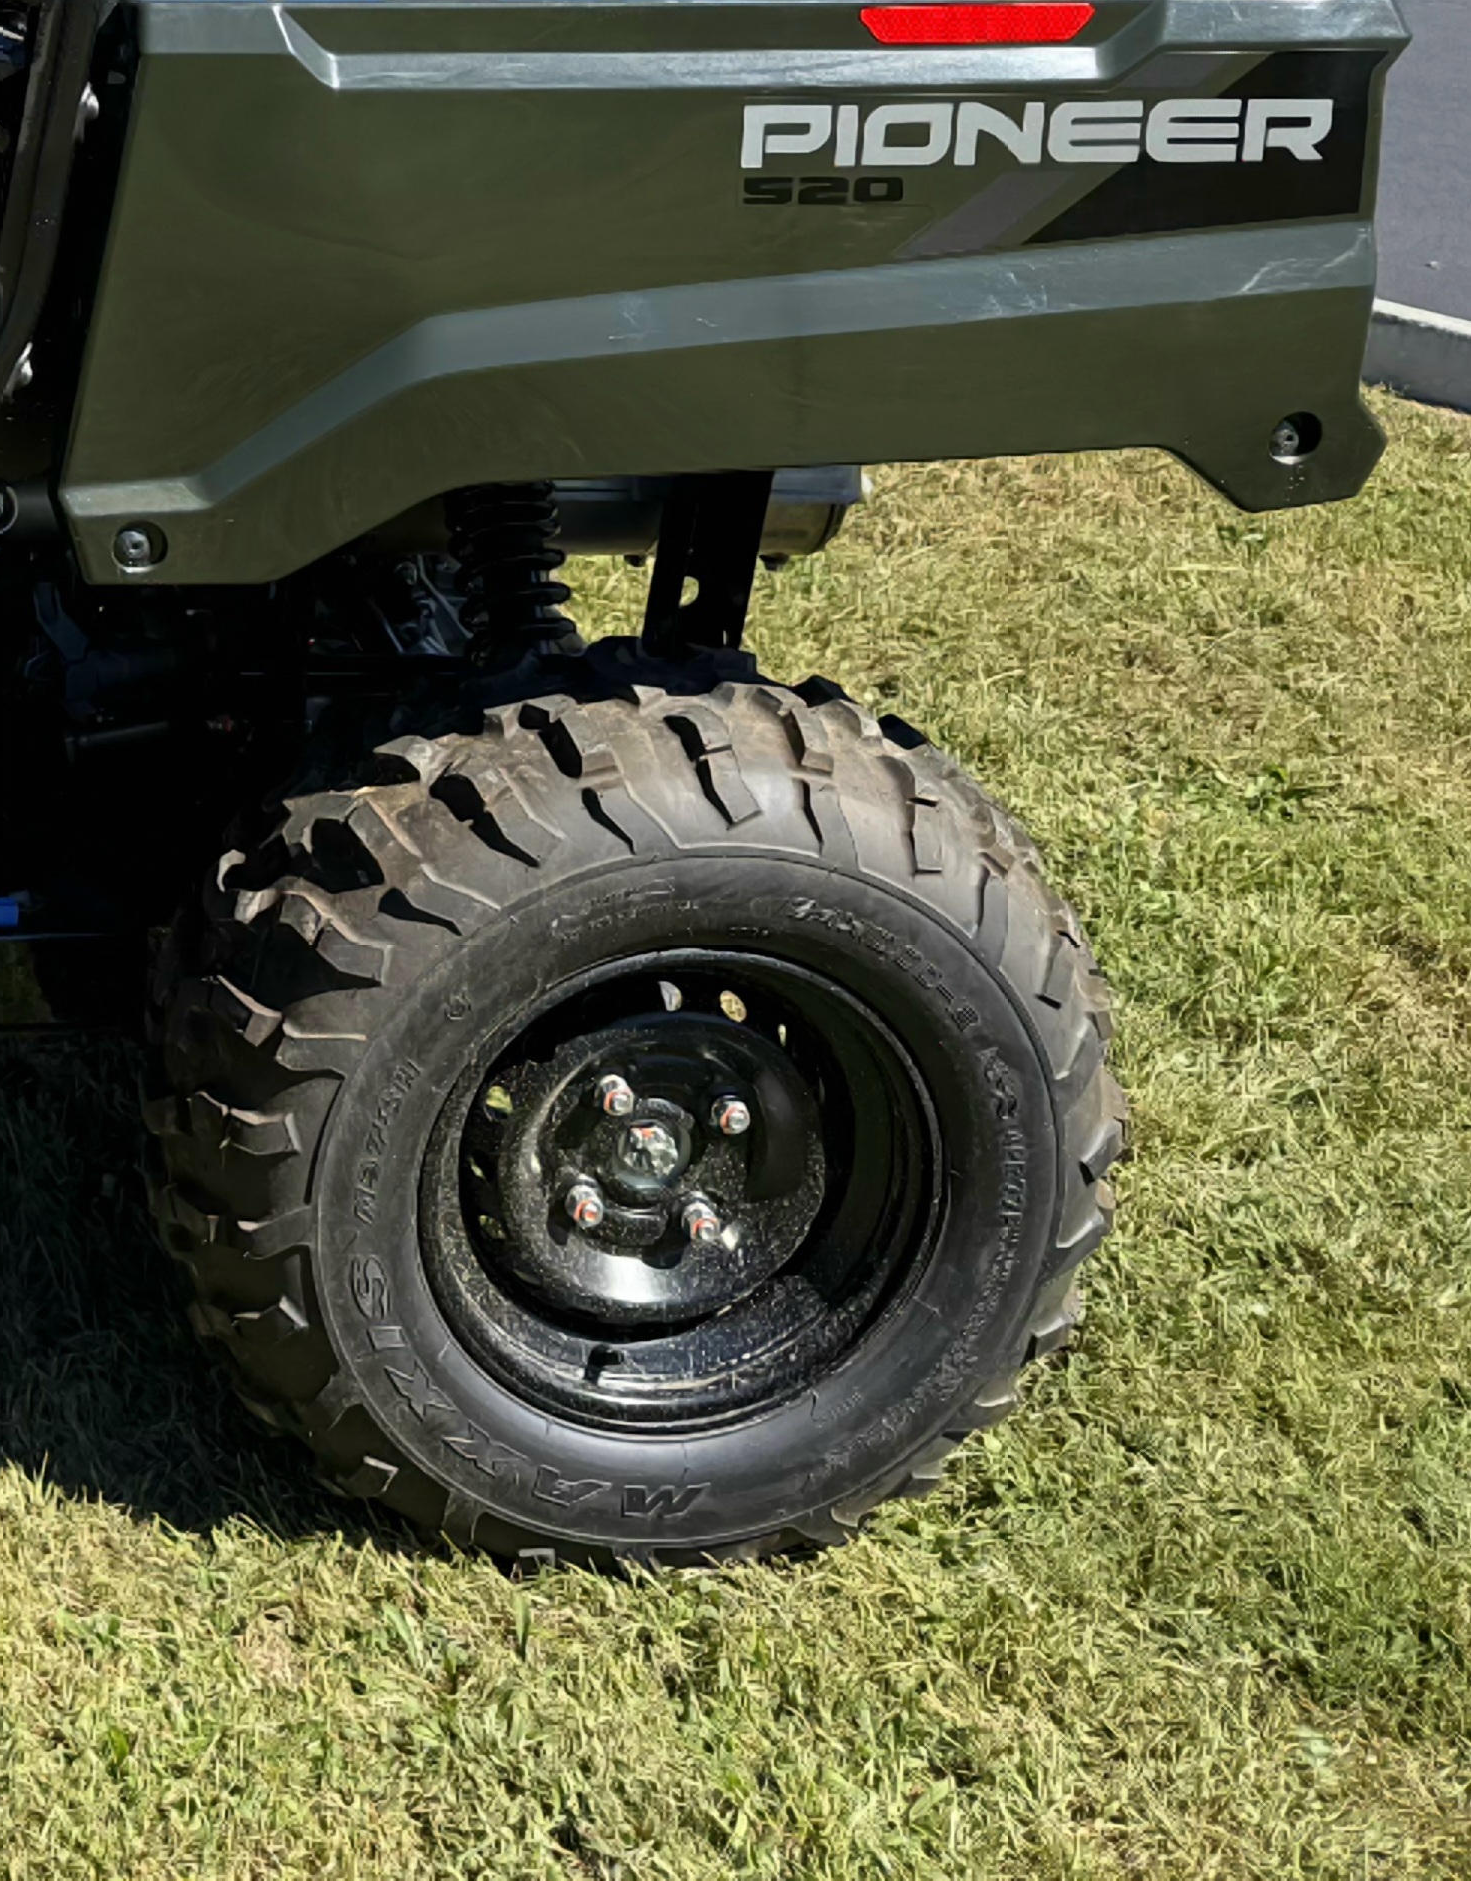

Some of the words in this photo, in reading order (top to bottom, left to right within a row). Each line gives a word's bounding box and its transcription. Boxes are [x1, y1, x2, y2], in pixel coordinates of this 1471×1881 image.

[740, 98, 1333, 169] PIONEER
[743, 175, 904, 206] 520
[349, 1256, 712, 1519] MAXXIS
